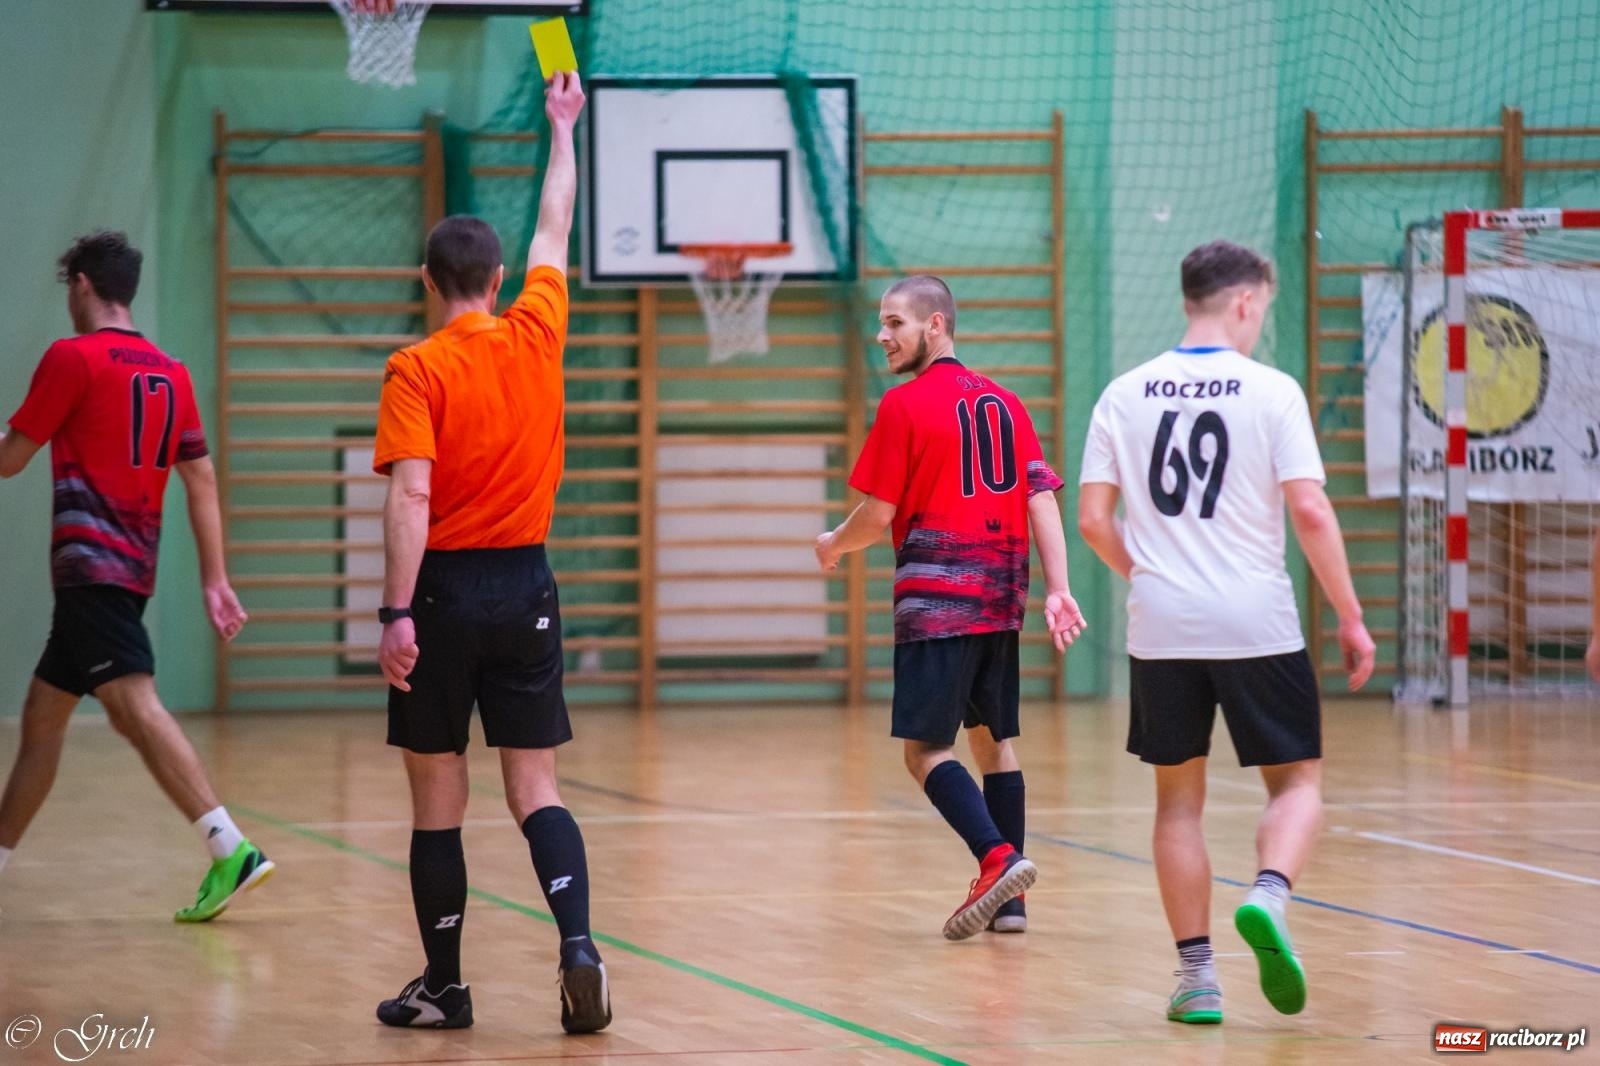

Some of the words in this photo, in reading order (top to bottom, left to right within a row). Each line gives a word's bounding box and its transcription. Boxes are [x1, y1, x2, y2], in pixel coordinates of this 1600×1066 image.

[130, 371, 175, 470] 17
[1144, 379, 1241, 399] KOCZOR
[956, 393, 1019, 498] 10
[1148, 410, 1229, 520] 69
